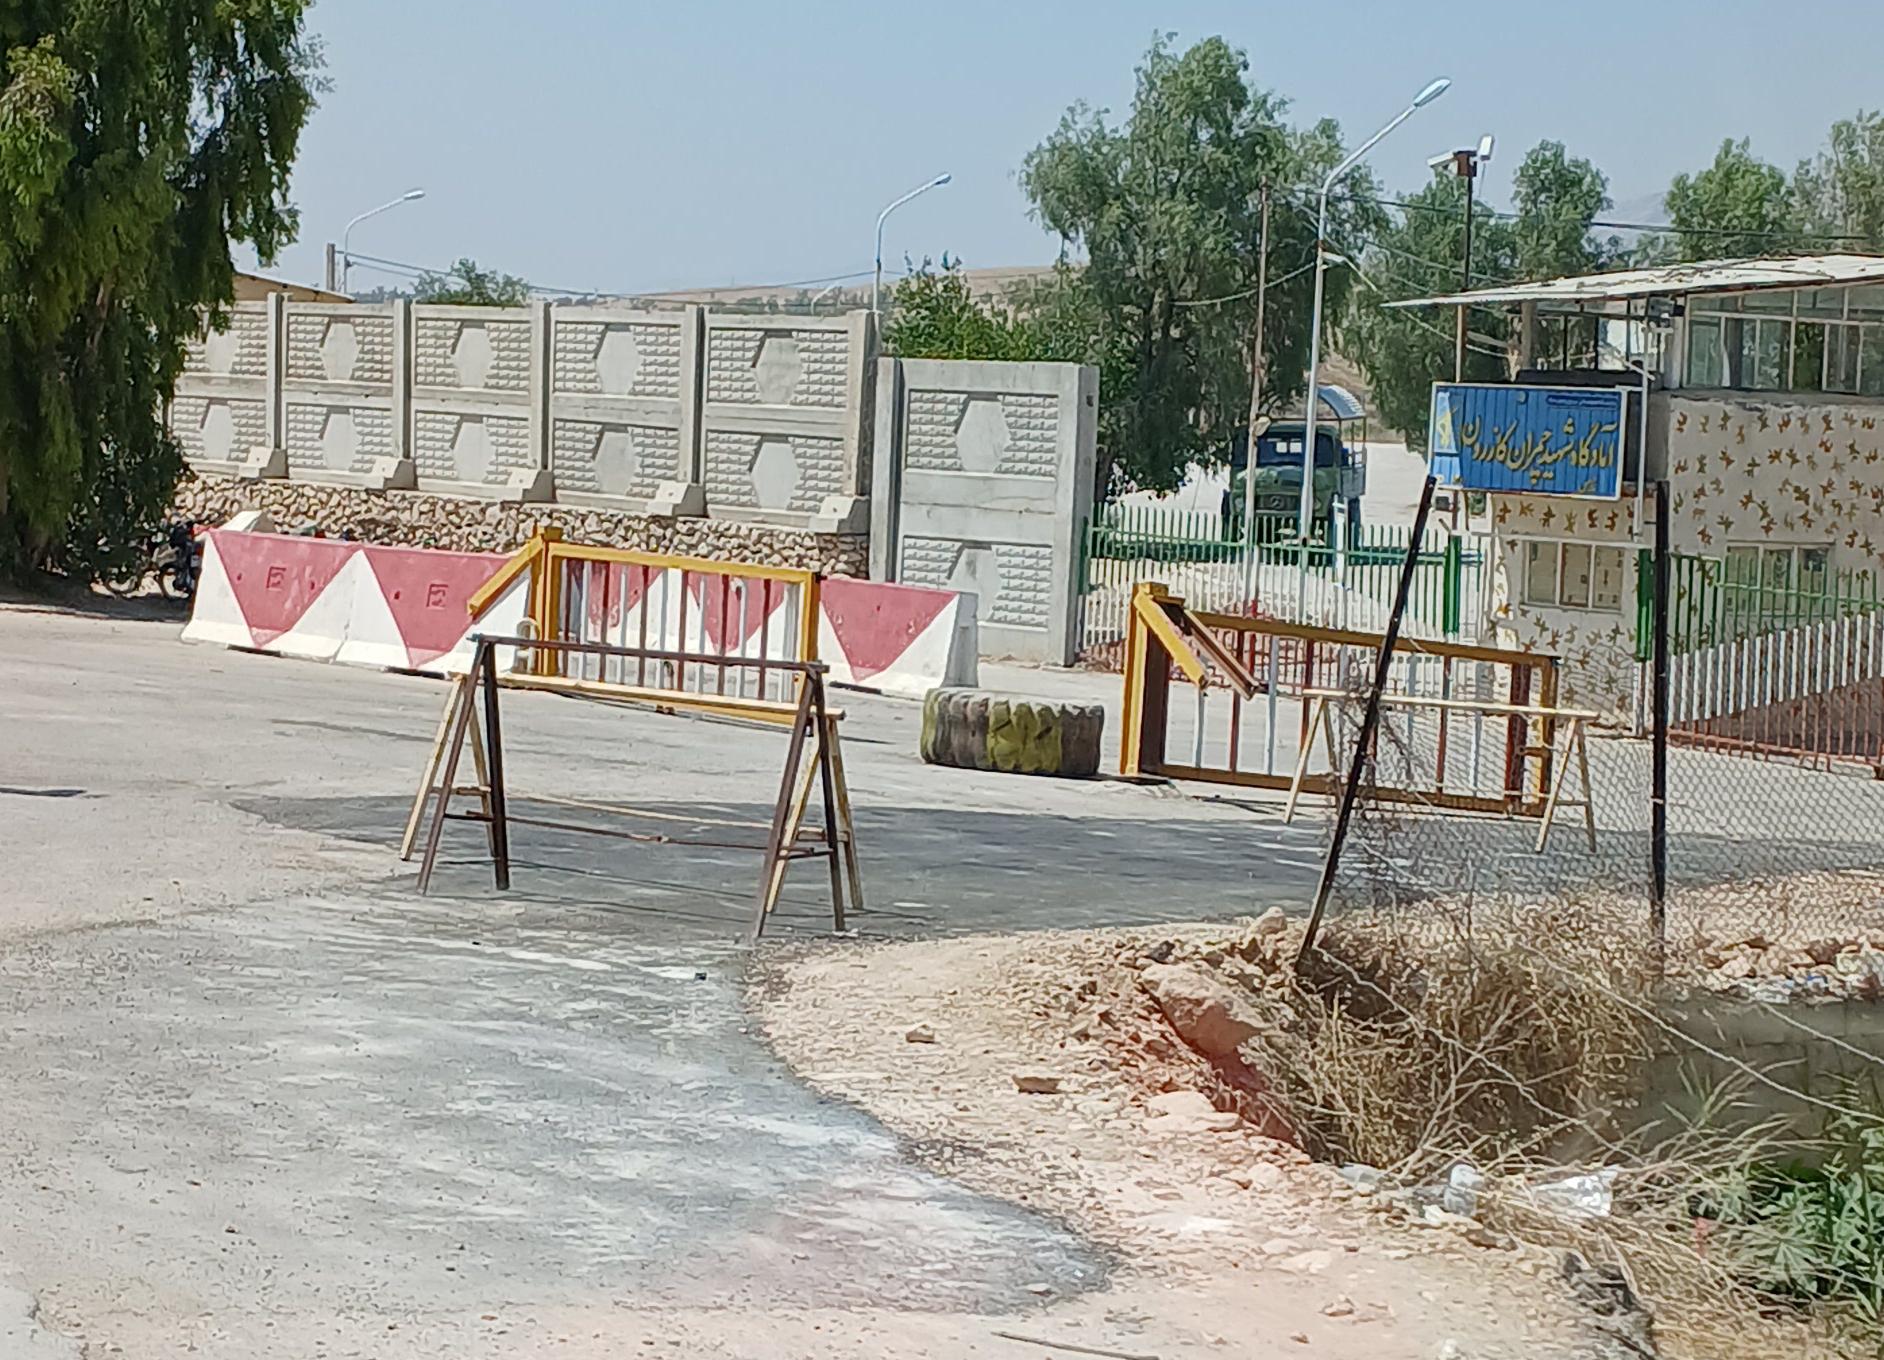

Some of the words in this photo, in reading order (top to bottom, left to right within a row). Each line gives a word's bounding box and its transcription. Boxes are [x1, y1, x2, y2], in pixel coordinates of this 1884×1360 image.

[1461, 415, 1518, 463] کازرون
[1506, 430, 1553, 485] چمران
[1536, 417, 1575, 479] شهید
[1570, 421, 1618, 468] آمادگاه
